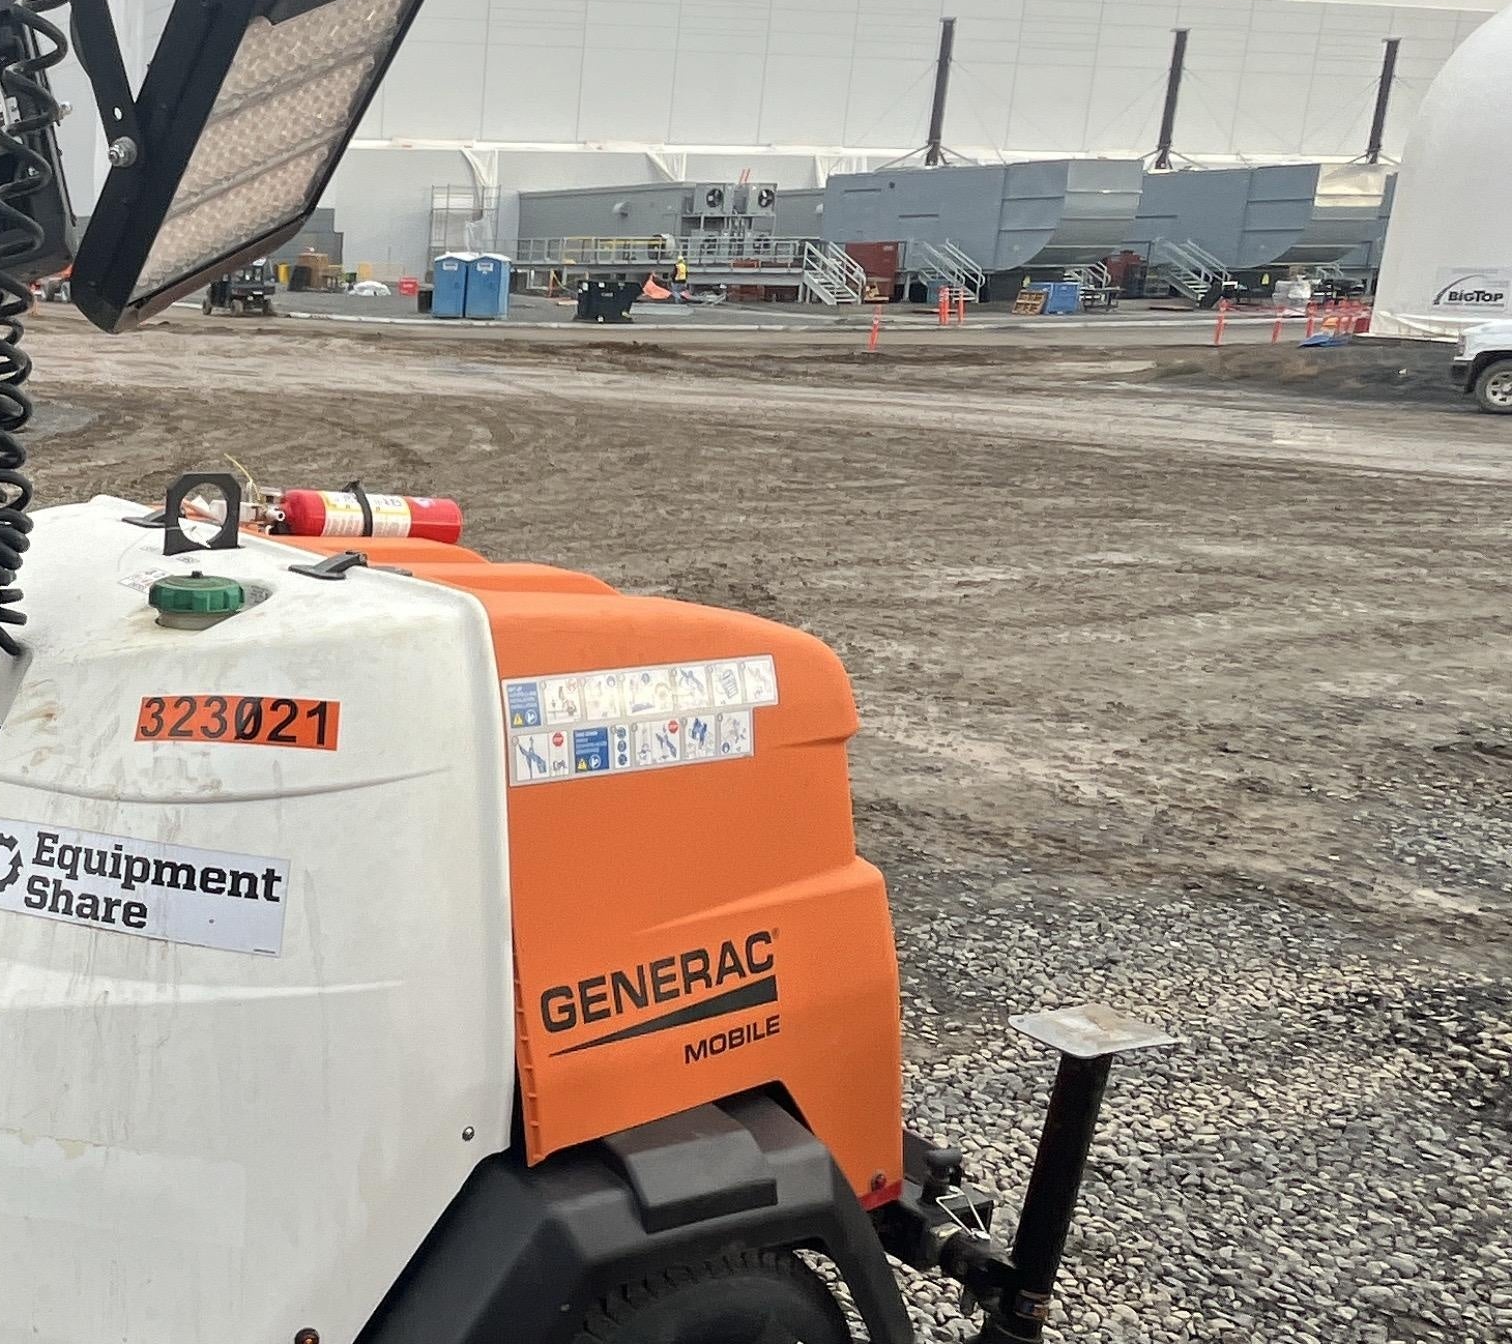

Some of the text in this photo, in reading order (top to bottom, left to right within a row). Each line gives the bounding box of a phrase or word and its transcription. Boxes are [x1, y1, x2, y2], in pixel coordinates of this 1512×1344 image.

[139, 695, 328, 747] 323021
[31, 830, 282, 903] Equipment
[23, 875, 148, 929] Share
[539, 930, 774, 1034] GENERAC
[684, 1014, 781, 1064] MOBILE
